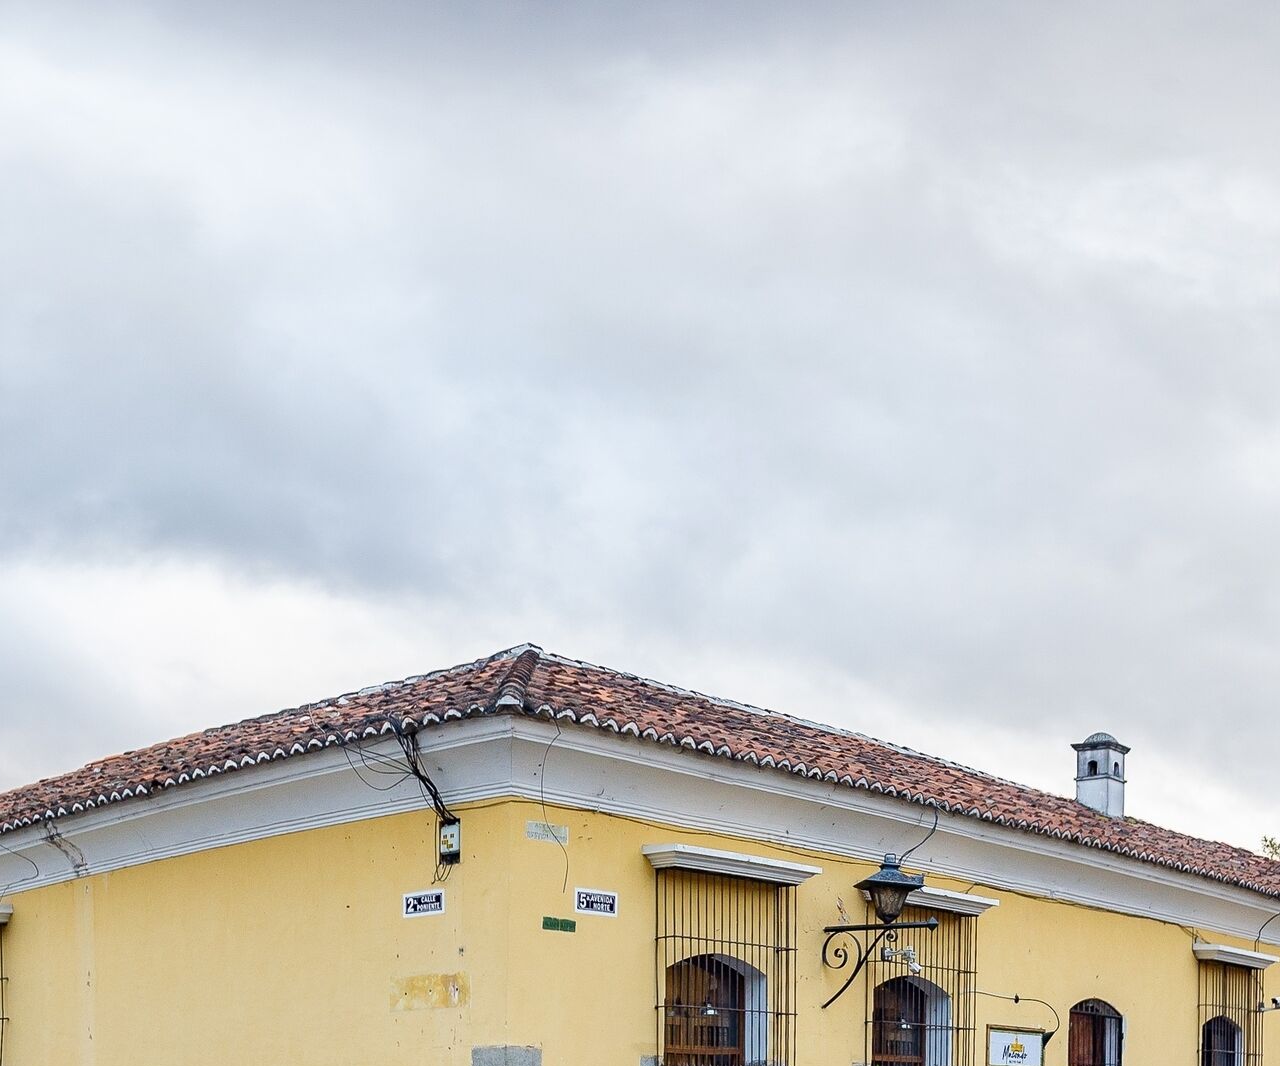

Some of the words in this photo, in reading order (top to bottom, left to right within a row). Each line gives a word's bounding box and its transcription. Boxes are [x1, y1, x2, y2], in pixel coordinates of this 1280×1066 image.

[421, 895, 436, 903] CALLE
[591, 894, 614, 904] AVENIDA
[417, 902, 440, 911] PONIENTE
[593, 902, 611, 912] NORTE
